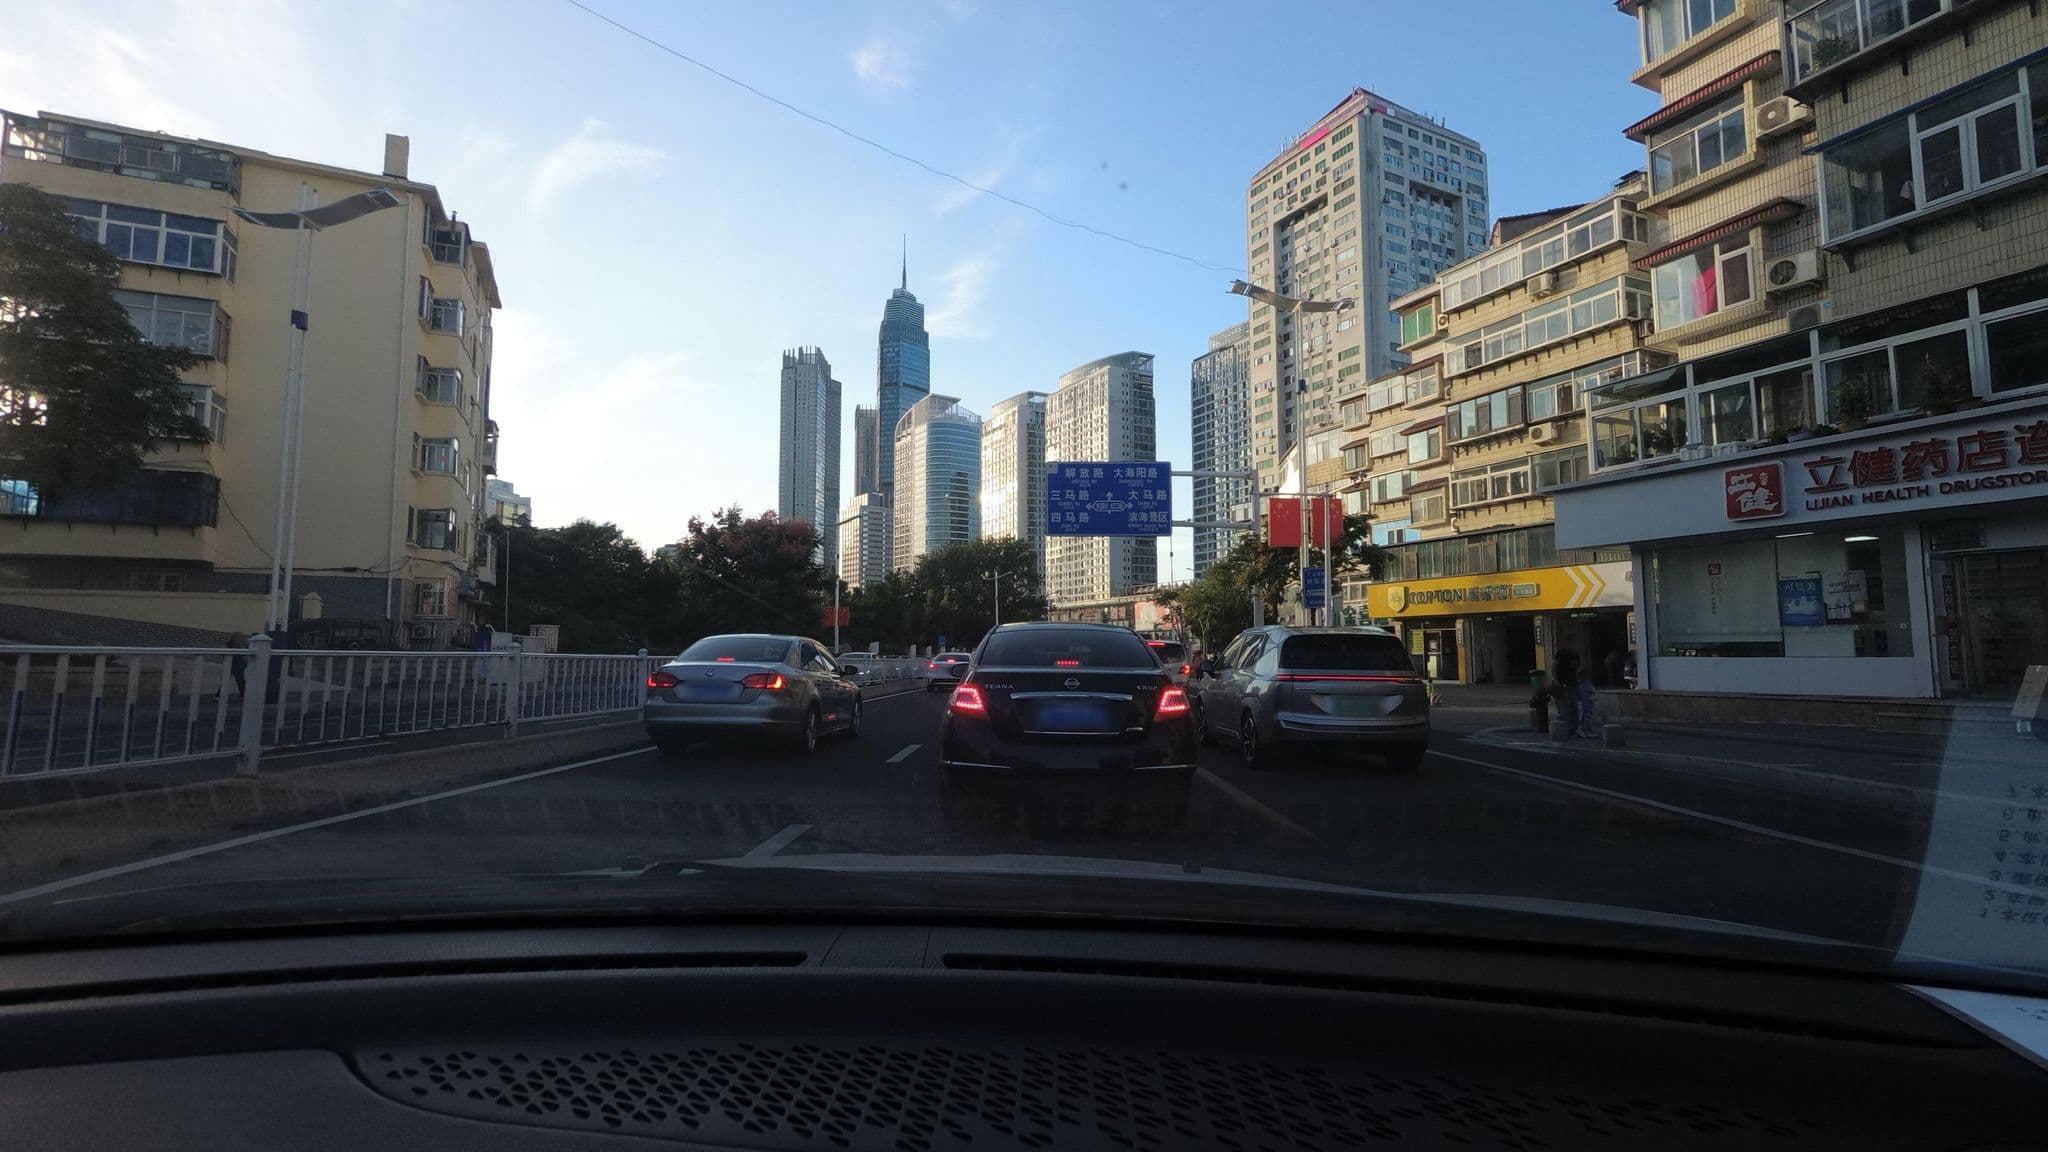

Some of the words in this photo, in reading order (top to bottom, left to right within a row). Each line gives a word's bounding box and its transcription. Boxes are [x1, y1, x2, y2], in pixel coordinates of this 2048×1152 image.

[1065, 467, 1104, 478] 解放路
[1113, 467, 1158, 478] 大海阳路
[1050, 490, 1089, 500] 三马路
[1128, 490, 1167, 500] 大马路
[1806, 494, 1853, 511] LIJIAN
[1862, 485, 1929, 504] HEALTH
[1051, 512, 1089, 523] 四马路
[1128, 511, 1168, 523] 滨海景区
